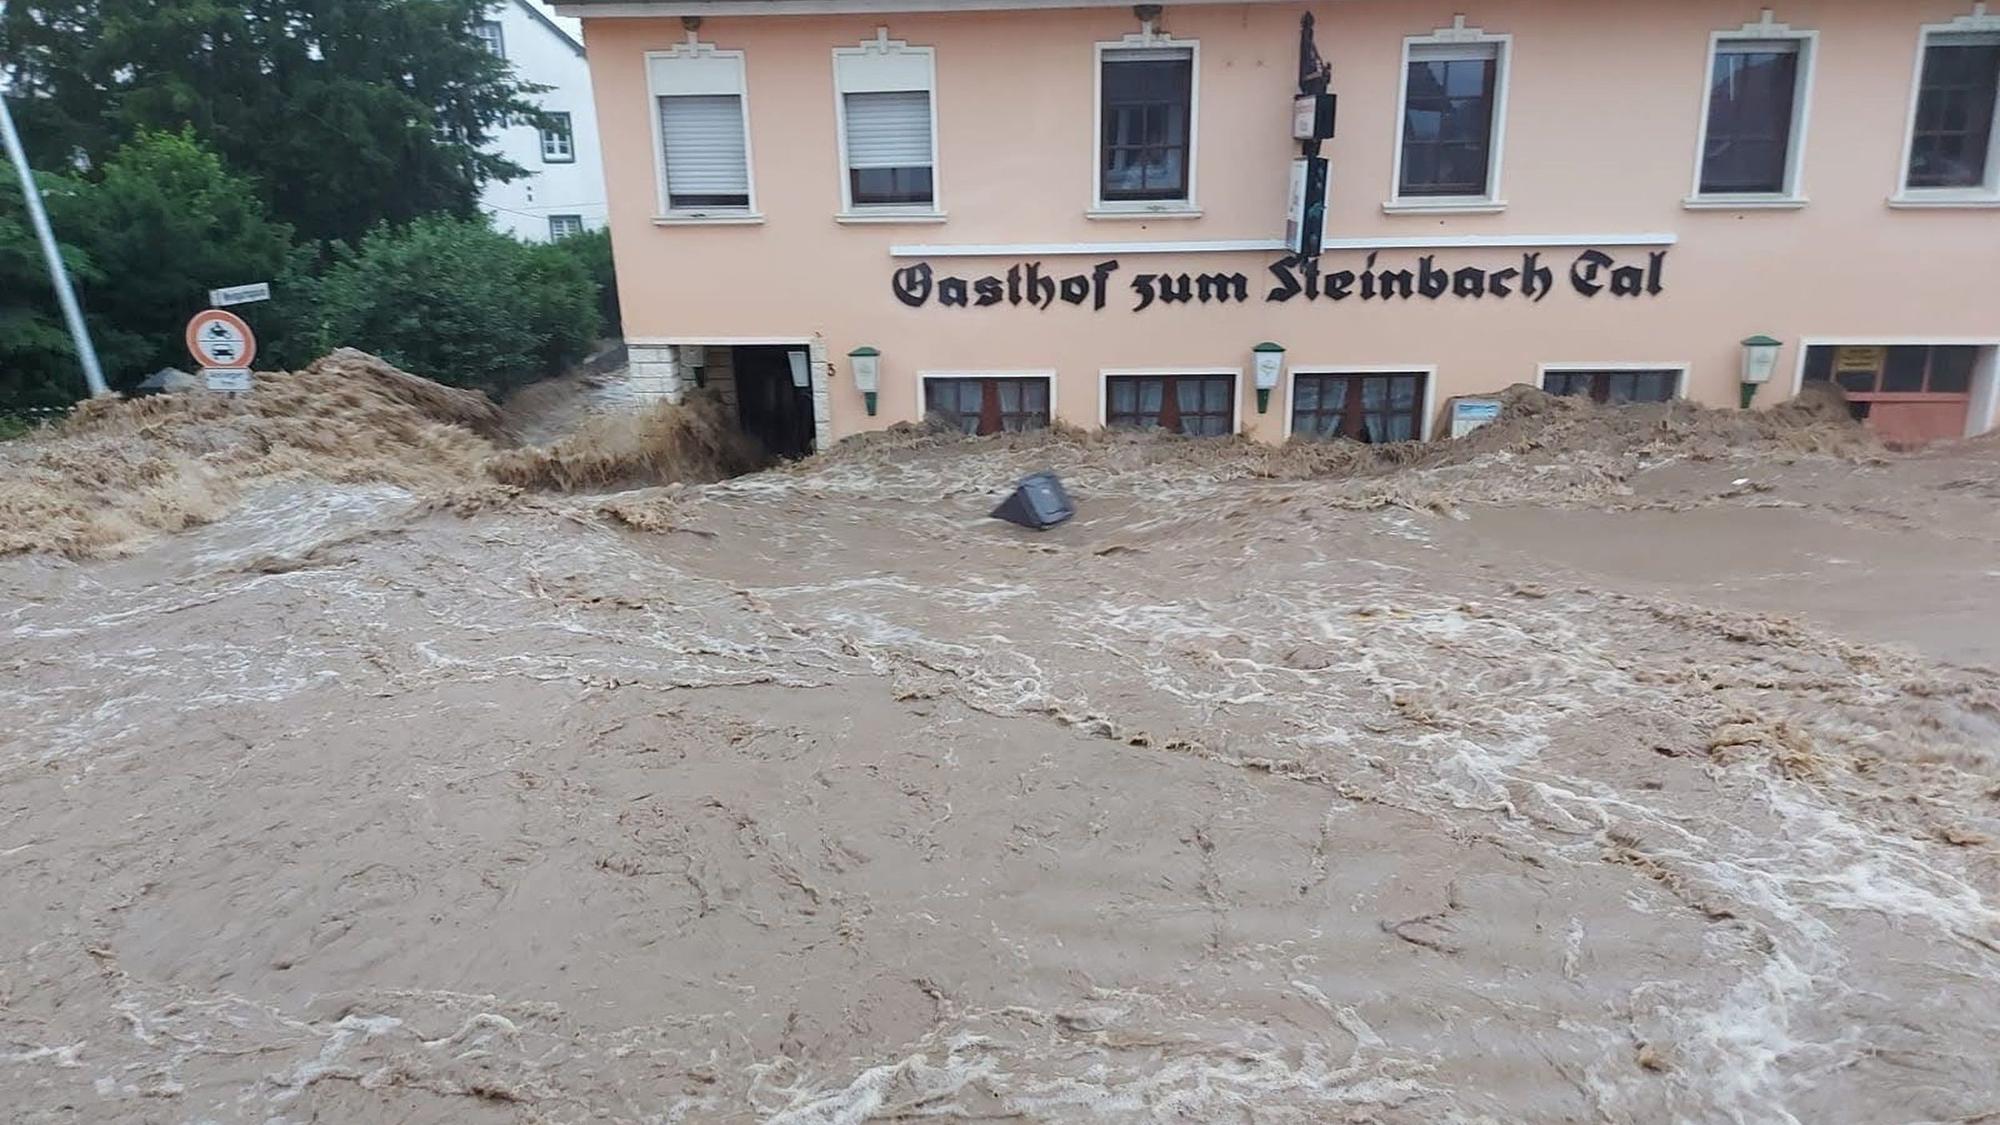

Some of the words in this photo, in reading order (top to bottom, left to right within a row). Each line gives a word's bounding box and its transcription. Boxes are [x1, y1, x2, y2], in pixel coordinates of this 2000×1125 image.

[892, 260, 1118, 311] Gasthof
[1131, 272, 1248, 312] zum
[1266, 251, 1552, 302] Steinbach
[1570, 250, 1667, 298] Tal
